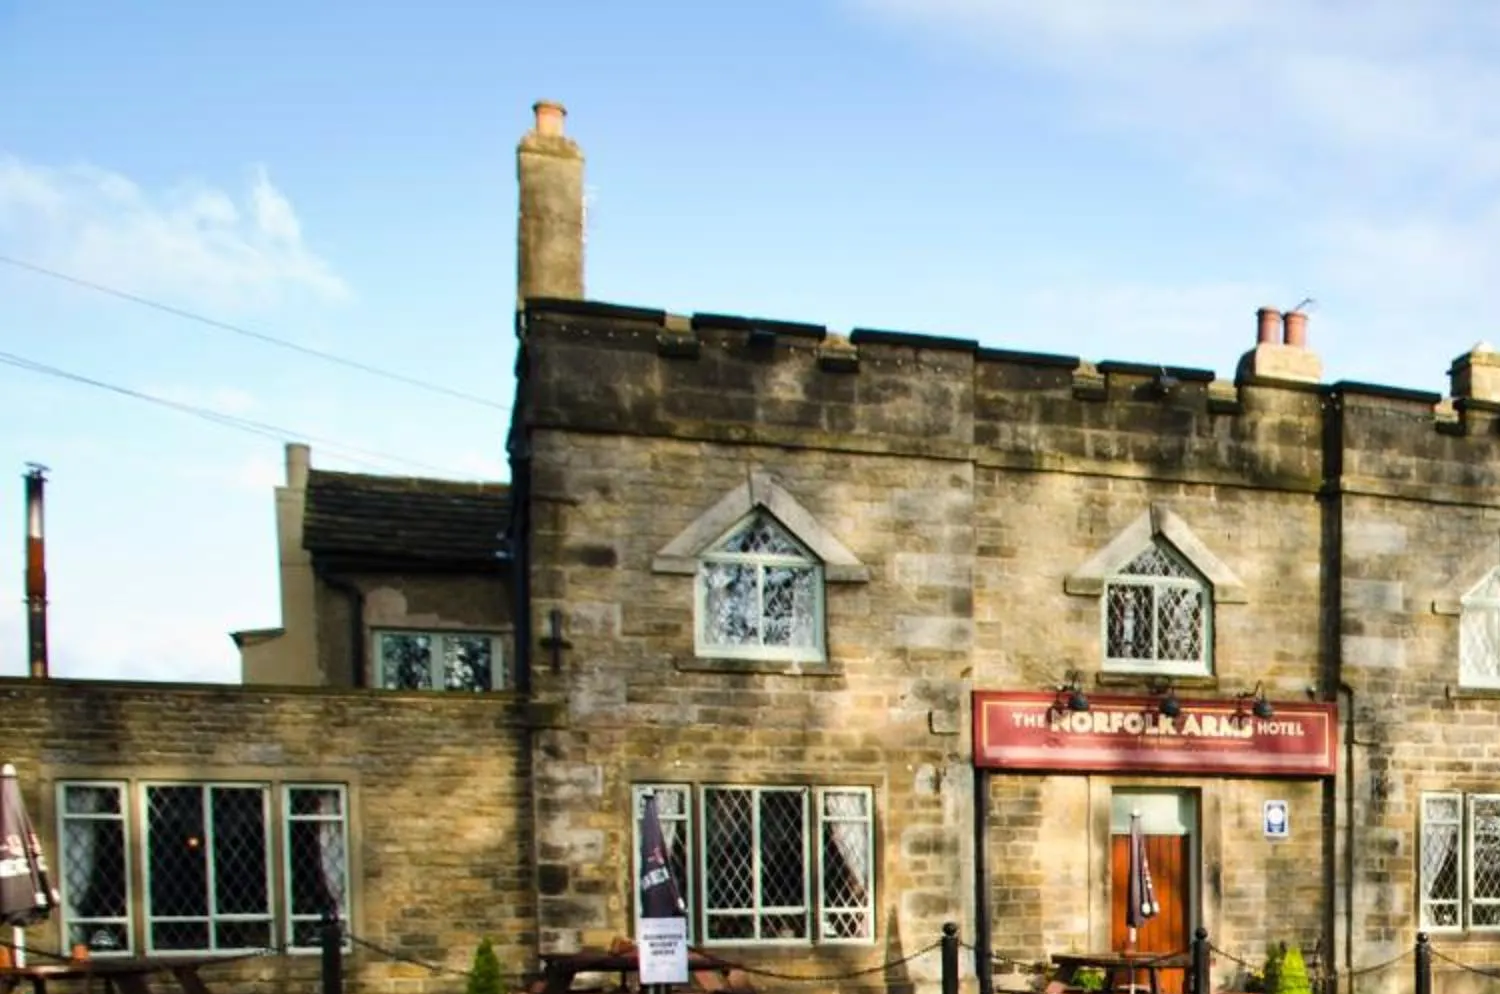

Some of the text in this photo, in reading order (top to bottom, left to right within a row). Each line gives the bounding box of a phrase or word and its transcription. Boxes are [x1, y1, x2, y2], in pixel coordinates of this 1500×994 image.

[1012, 711, 1305, 738] THE NORFOLK ARMS HOTEL
